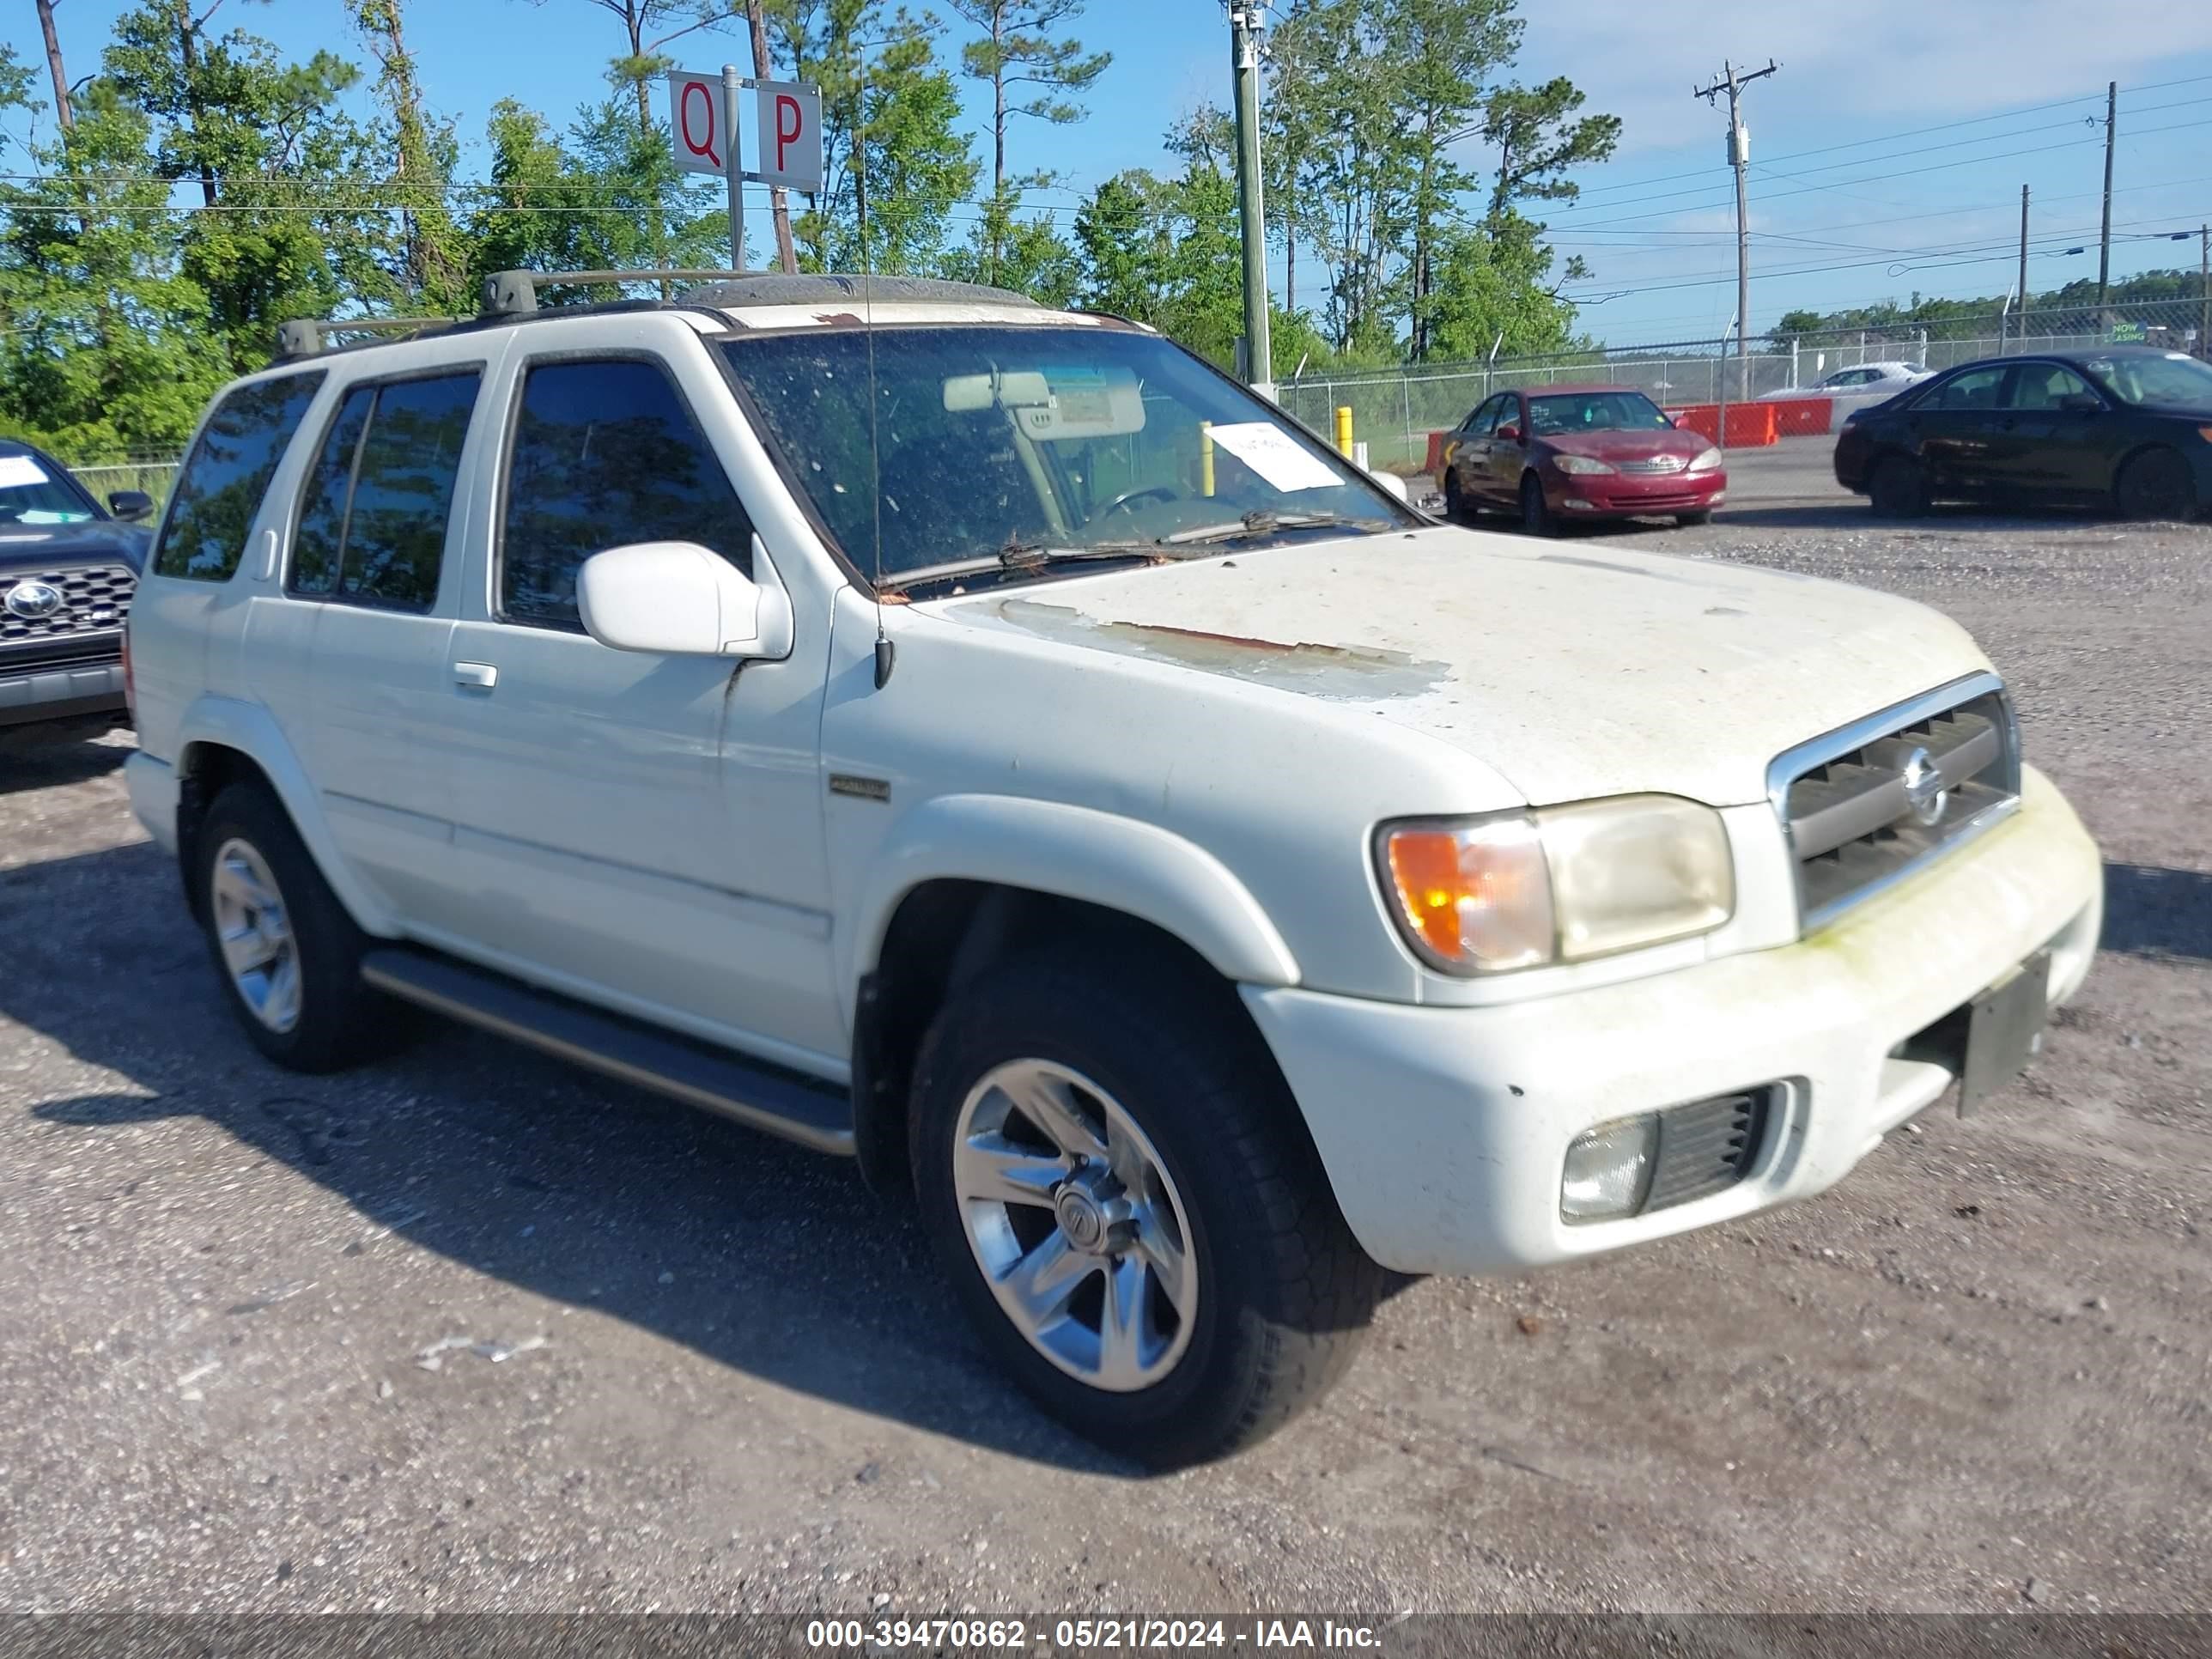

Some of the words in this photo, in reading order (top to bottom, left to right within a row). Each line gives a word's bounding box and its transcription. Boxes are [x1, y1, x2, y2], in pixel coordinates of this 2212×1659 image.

[681, 82, 720, 167] Q
[776, 94, 802, 172] P
[2113, 324, 2137, 332] NOW
